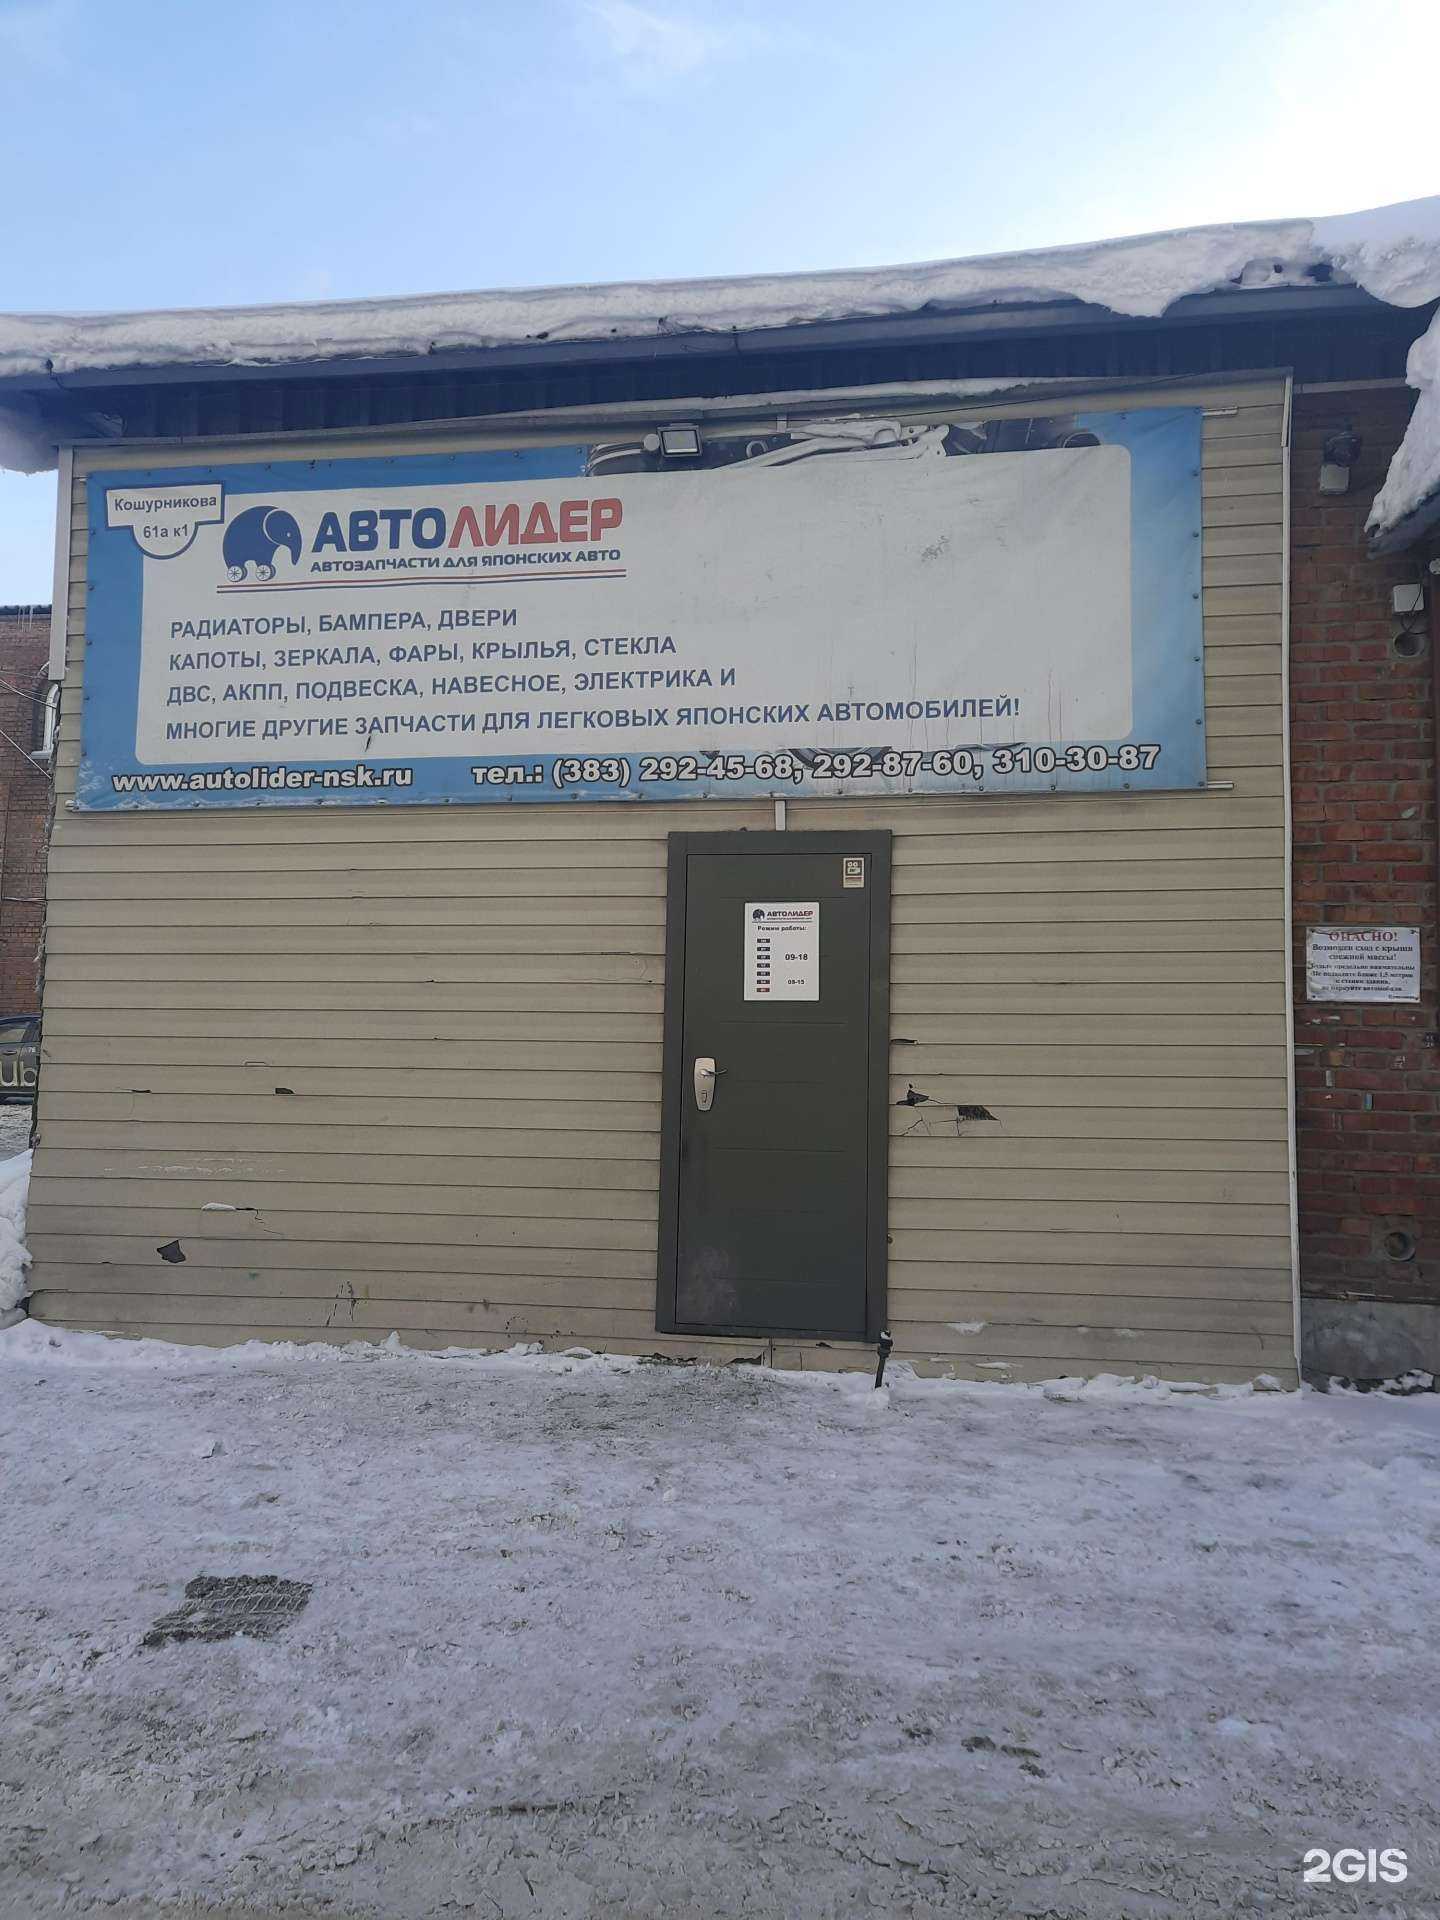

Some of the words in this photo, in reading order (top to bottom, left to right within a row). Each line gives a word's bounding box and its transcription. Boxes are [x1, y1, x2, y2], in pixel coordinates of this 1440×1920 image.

[114, 494, 217, 513] Кошурникова
[143, 524, 170, 539] 61а
[174, 524, 189, 538] к1
[312, 498, 623, 552] АВТОЛИДЕР
[311, 557, 439, 572] АВТОЗАПЧАСТИ
[444, 555, 477, 568] ДЛЯ
[481, 551, 571, 565] ЯПОНСКИХ
[576, 550, 620, 562] АВТО
[171, 616, 311, 639] РАДИАТОРЫ,
[318, 612, 431, 633] БАМПЕРА,
[438, 609, 518, 631] ДВЕРИ
[169, 650, 266, 673] КАПОТЫ,
[273, 646, 381, 668] ЗЕРКАЛА,
[389, 643, 465, 664] ФАРЫ,
[472, 640, 577, 662] КРЫЛЬЯ,
[585, 638, 675, 656] СТЕКЛА
[167, 684, 215, 706] ДВС,
[223, 682, 288, 704] АКПП,
[296, 678, 423, 700] ПОДВЕСКА,
[431, 674, 566, 695] НАВЕСНОЕ,
[574, 669, 711, 691] ЭЛЕКТРИКА
[720, 668, 736, 687] И
[166, 719, 256, 741] МНОГИЕ
[262, 716, 348, 740] ДРУГИЕ
[355, 713, 475, 737] ЗАПЧАСТИ
[483, 711, 530, 734] ДЛЯ
[538, 705, 669, 728] ЛЕГКОВЫХ
[676, 702, 809, 726] ЯПОНСКИХ
[816, 694, 1020, 722] АВТОМОБИЛЕЙ!
[112, 765, 413, 794] www.autolider-nsk.ru
[473, 765, 543, 784] тел.:
[552, 757, 632, 788] (383)
[639, 750, 804, 785] 292-45-68,
[812, 749, 984, 781] 292-87-60,
[992, 744, 1161, 774] 310-30-87
[1329, 931, 1398, 942] ОПАСНО!
